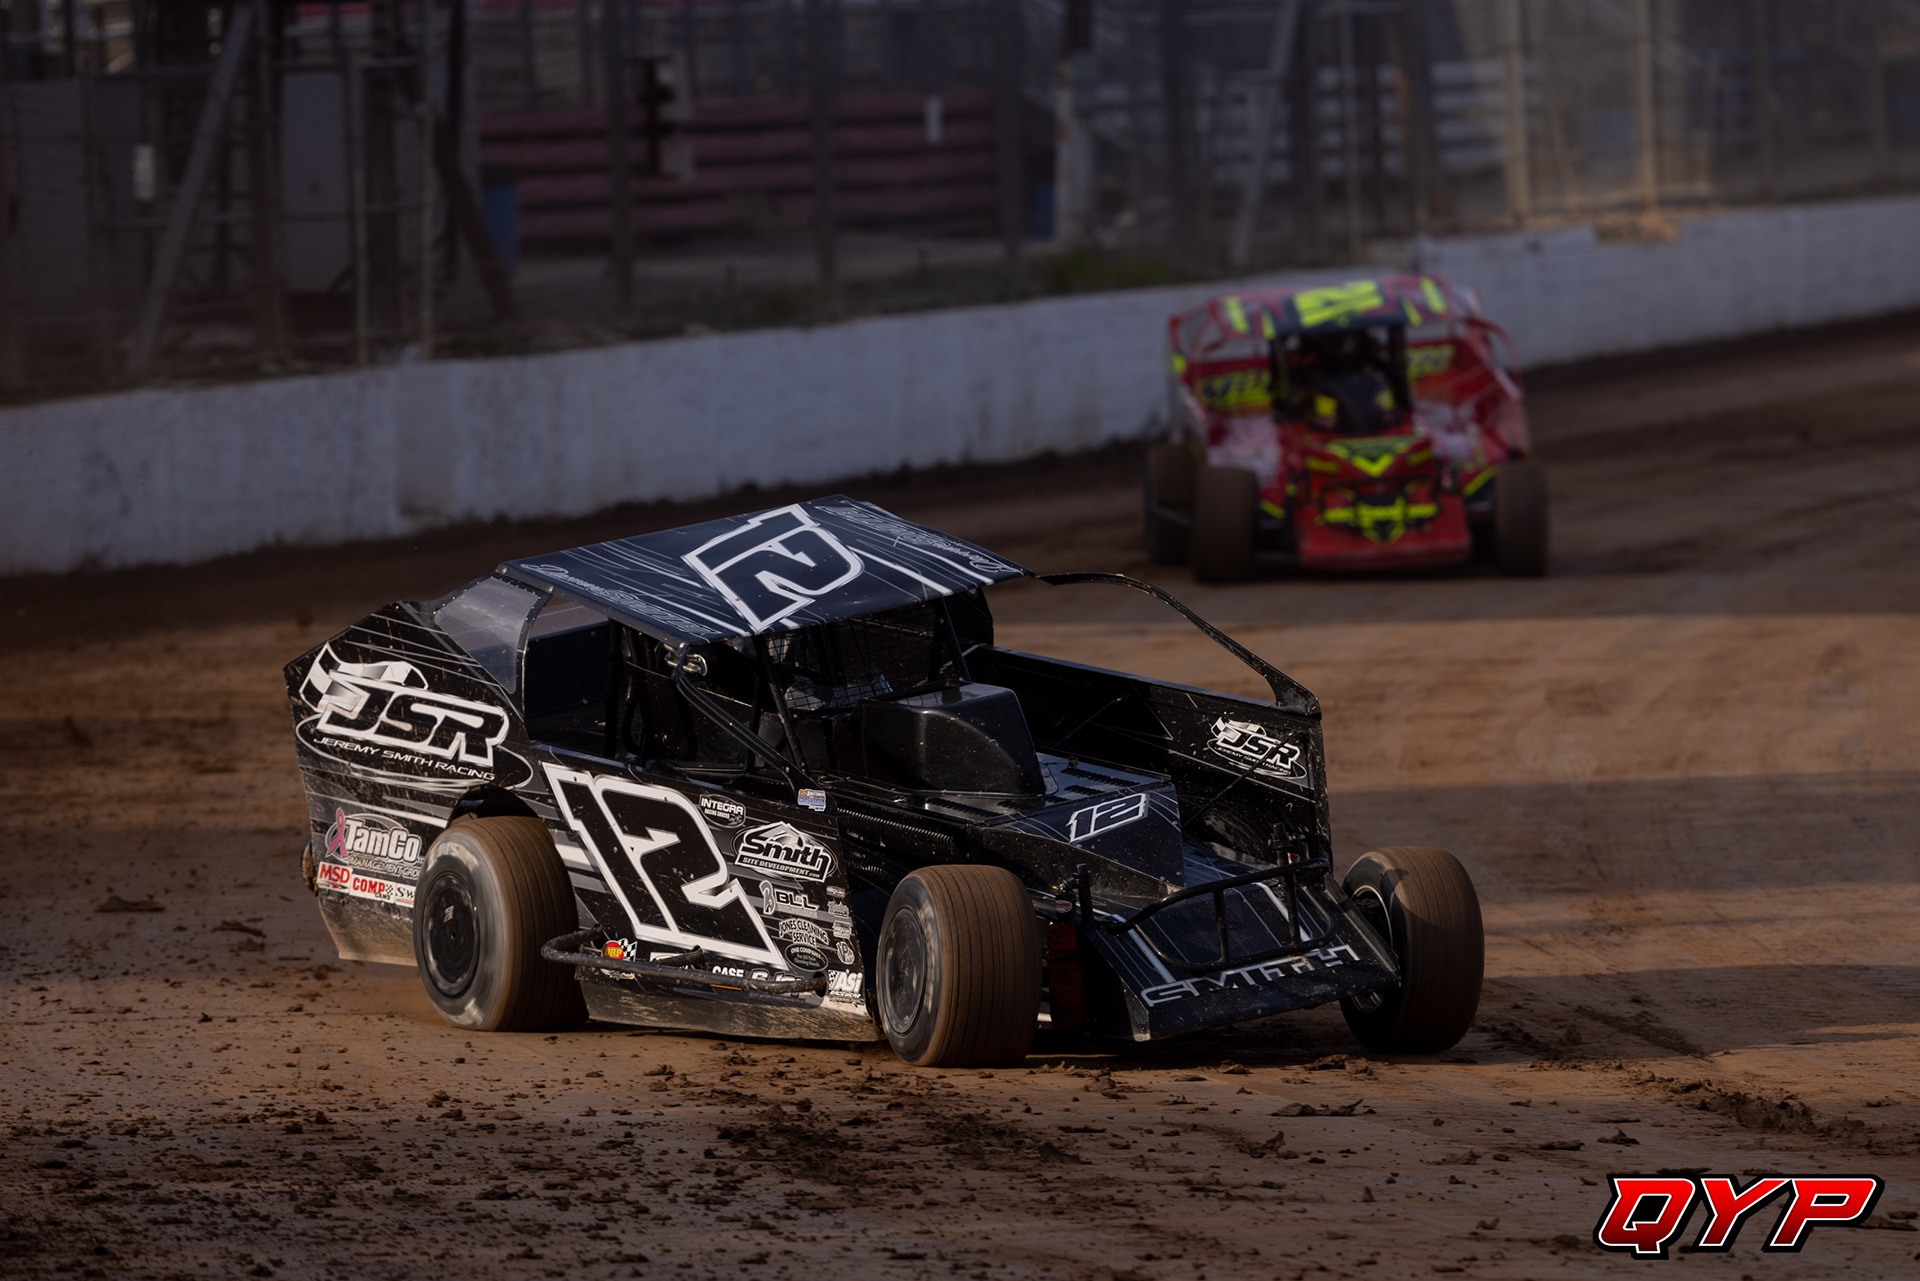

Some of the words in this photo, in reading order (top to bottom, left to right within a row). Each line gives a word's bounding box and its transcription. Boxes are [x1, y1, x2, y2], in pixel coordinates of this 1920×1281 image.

[681, 502, 867, 633] 12
[315, 669, 511, 768] JSR
[313, 735, 381, 755] JEREMY
[381, 749, 434, 768] SMITH
[434, 760, 497, 782] RACING
[1215, 722, 1302, 770] JSR
[701, 797, 744, 816] INTEGRA
[1065, 793, 1150, 844] 12
[345, 817, 421, 863] TamCo
[740, 826, 830, 871] Smith
[742, 856, 760, 867] SITE
[319, 864, 351, 883] MSD
[349, 855, 403, 876] MANAGEMENT
[403, 865, 421, 879] GRO
[352, 877, 386, 895] COMP
[541, 763, 790, 970] 12
[780, 919, 797, 937] JONES
[796, 918, 828, 944] CLEANING
[793, 931, 816, 946] SERVICE
